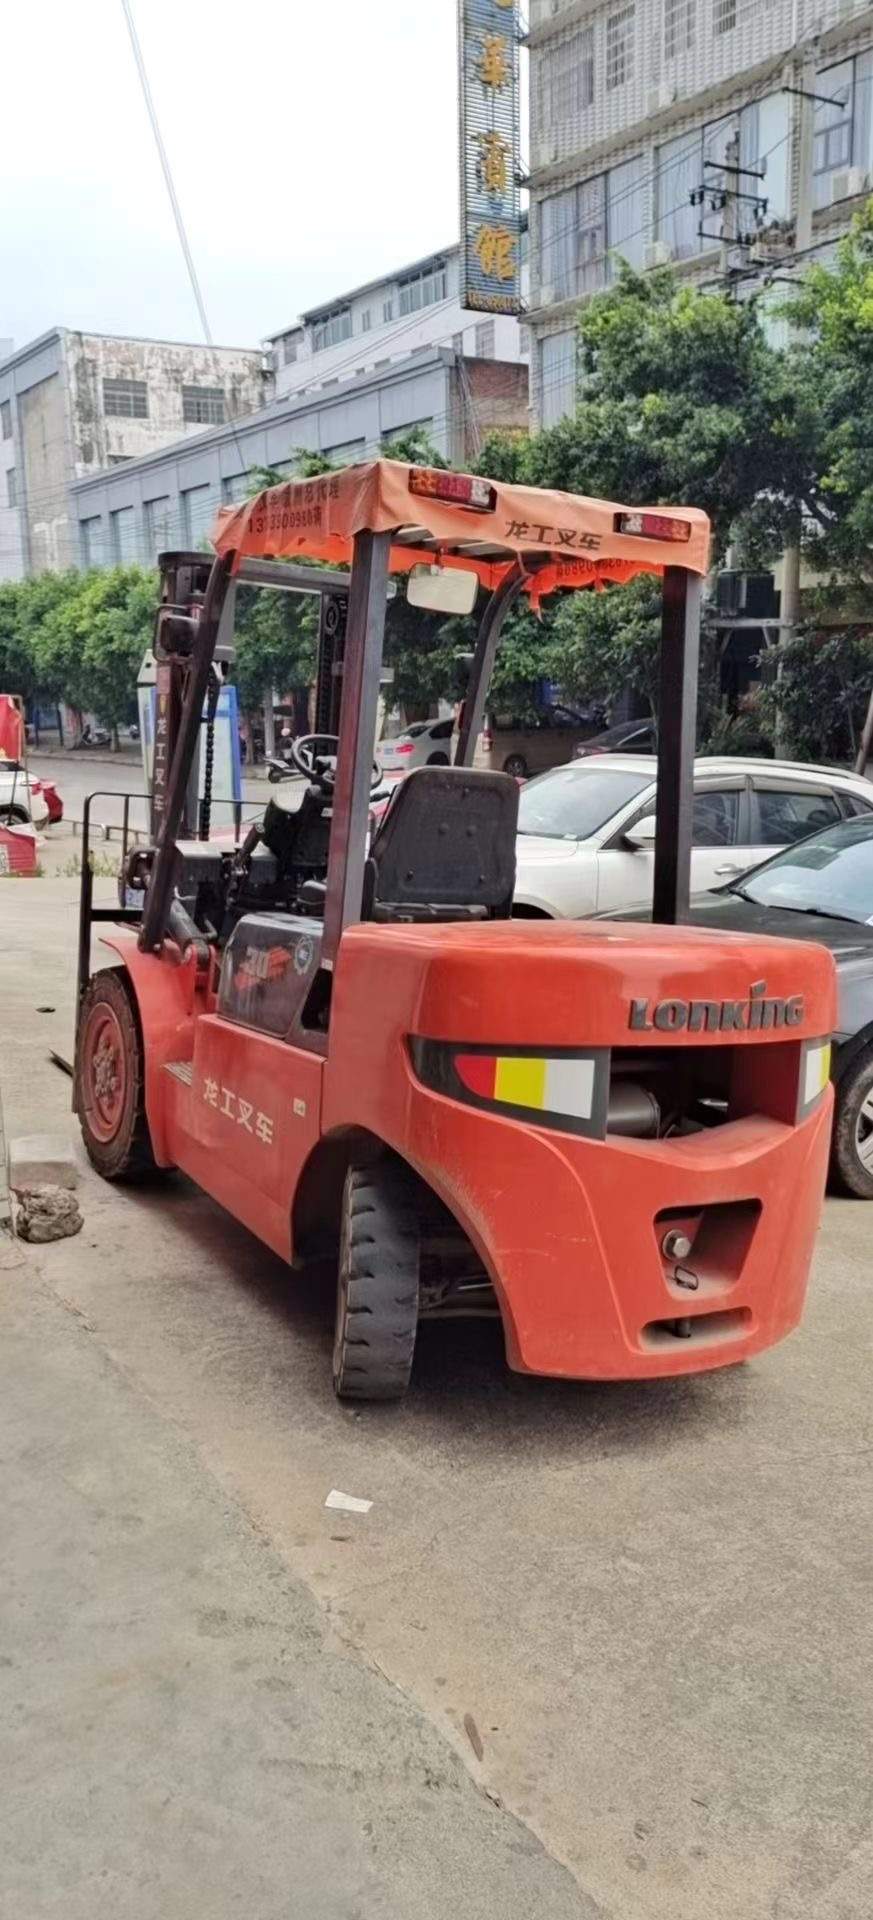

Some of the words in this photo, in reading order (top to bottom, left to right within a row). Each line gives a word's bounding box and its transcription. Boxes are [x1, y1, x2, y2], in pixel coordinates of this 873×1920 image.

[504, 519, 602, 550] 龙工叉车
[154, 717, 167, 811] 龙工叉车
[203, 1077, 274, 1144] 龙工叉车
